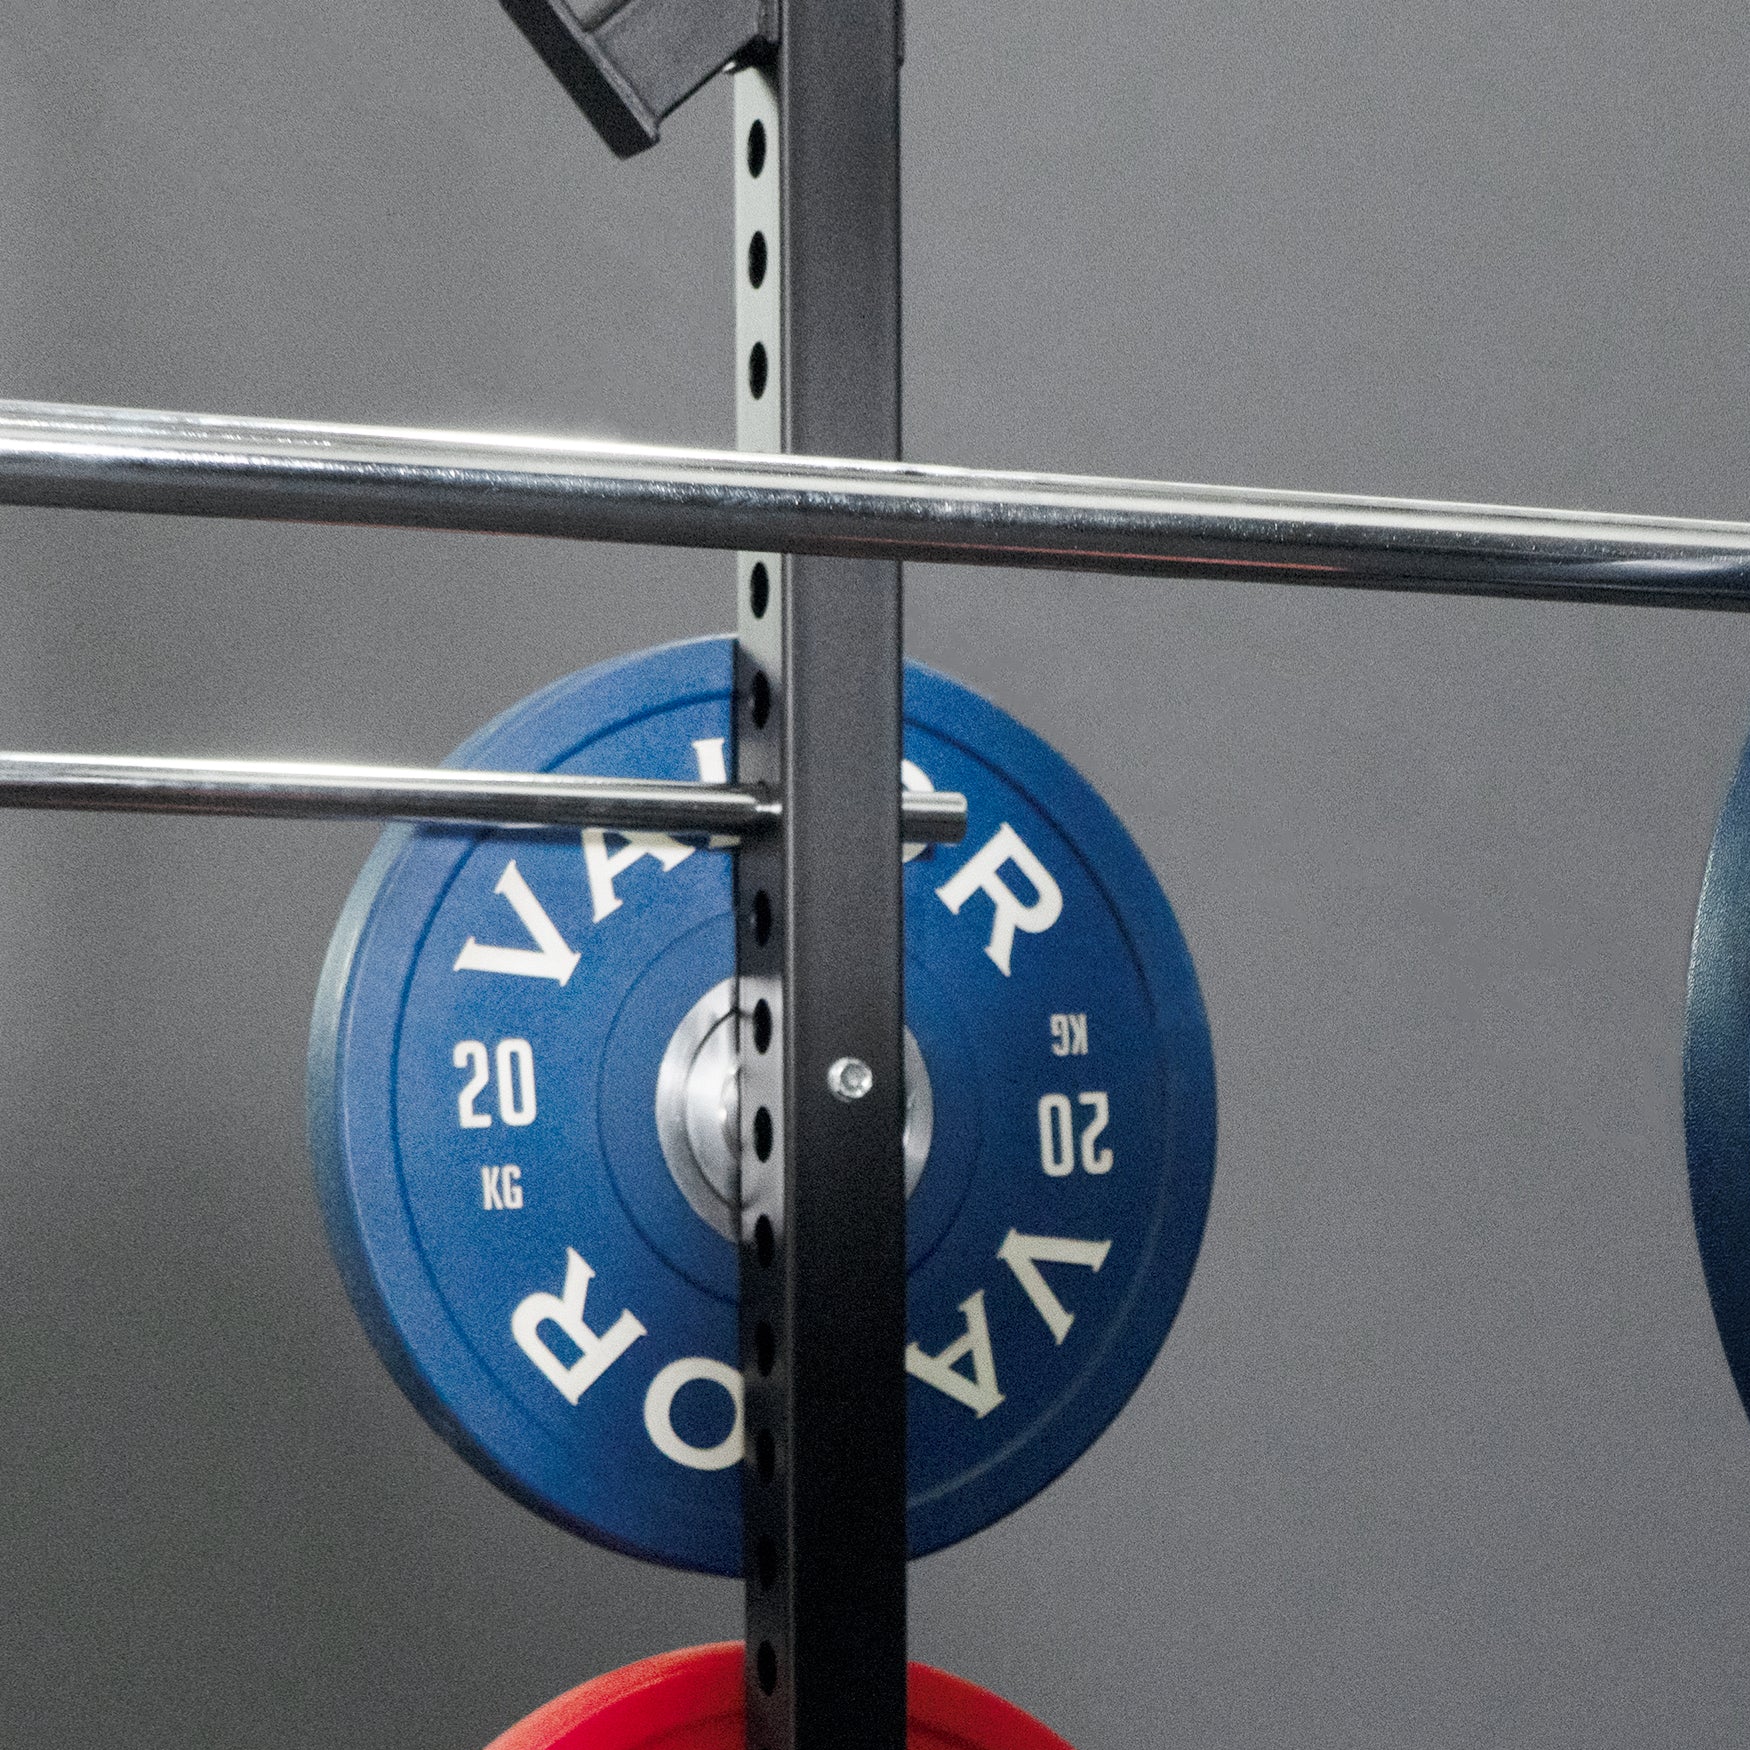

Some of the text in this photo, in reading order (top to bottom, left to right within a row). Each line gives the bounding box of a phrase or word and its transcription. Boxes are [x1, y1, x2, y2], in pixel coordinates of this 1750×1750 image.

[1051, 1013, 1088, 1057] KG
[453, 1037, 537, 1129] 20
[1039, 1091, 1113, 1178] 20
[481, 1164, 524, 1211] KG
[511, 1229, 1112, 1471] VAOR
